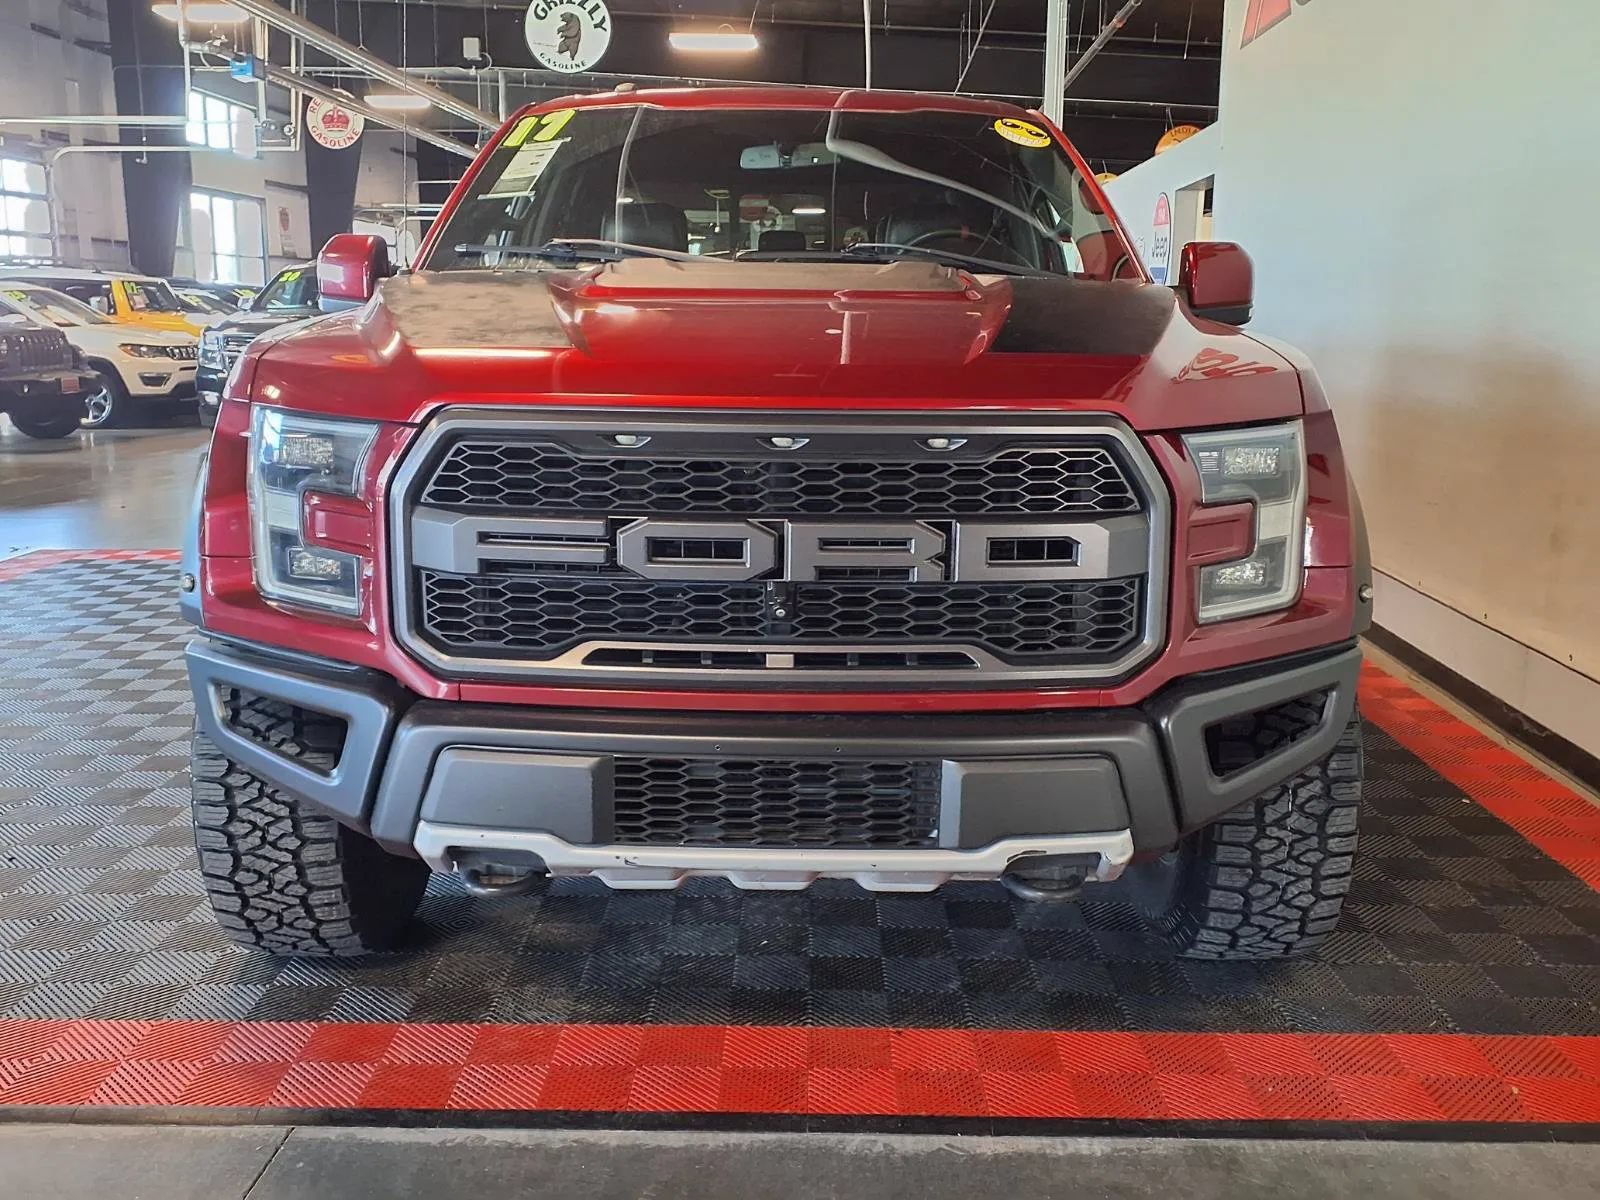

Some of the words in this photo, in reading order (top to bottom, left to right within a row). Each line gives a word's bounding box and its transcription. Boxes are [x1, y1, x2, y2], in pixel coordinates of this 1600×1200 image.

[539, 52, 587, 70] GASOLINE
[311, 125, 359, 147] GASOLINE
[503, 109, 576, 148] 17
[413, 515, 1147, 583] FORD
